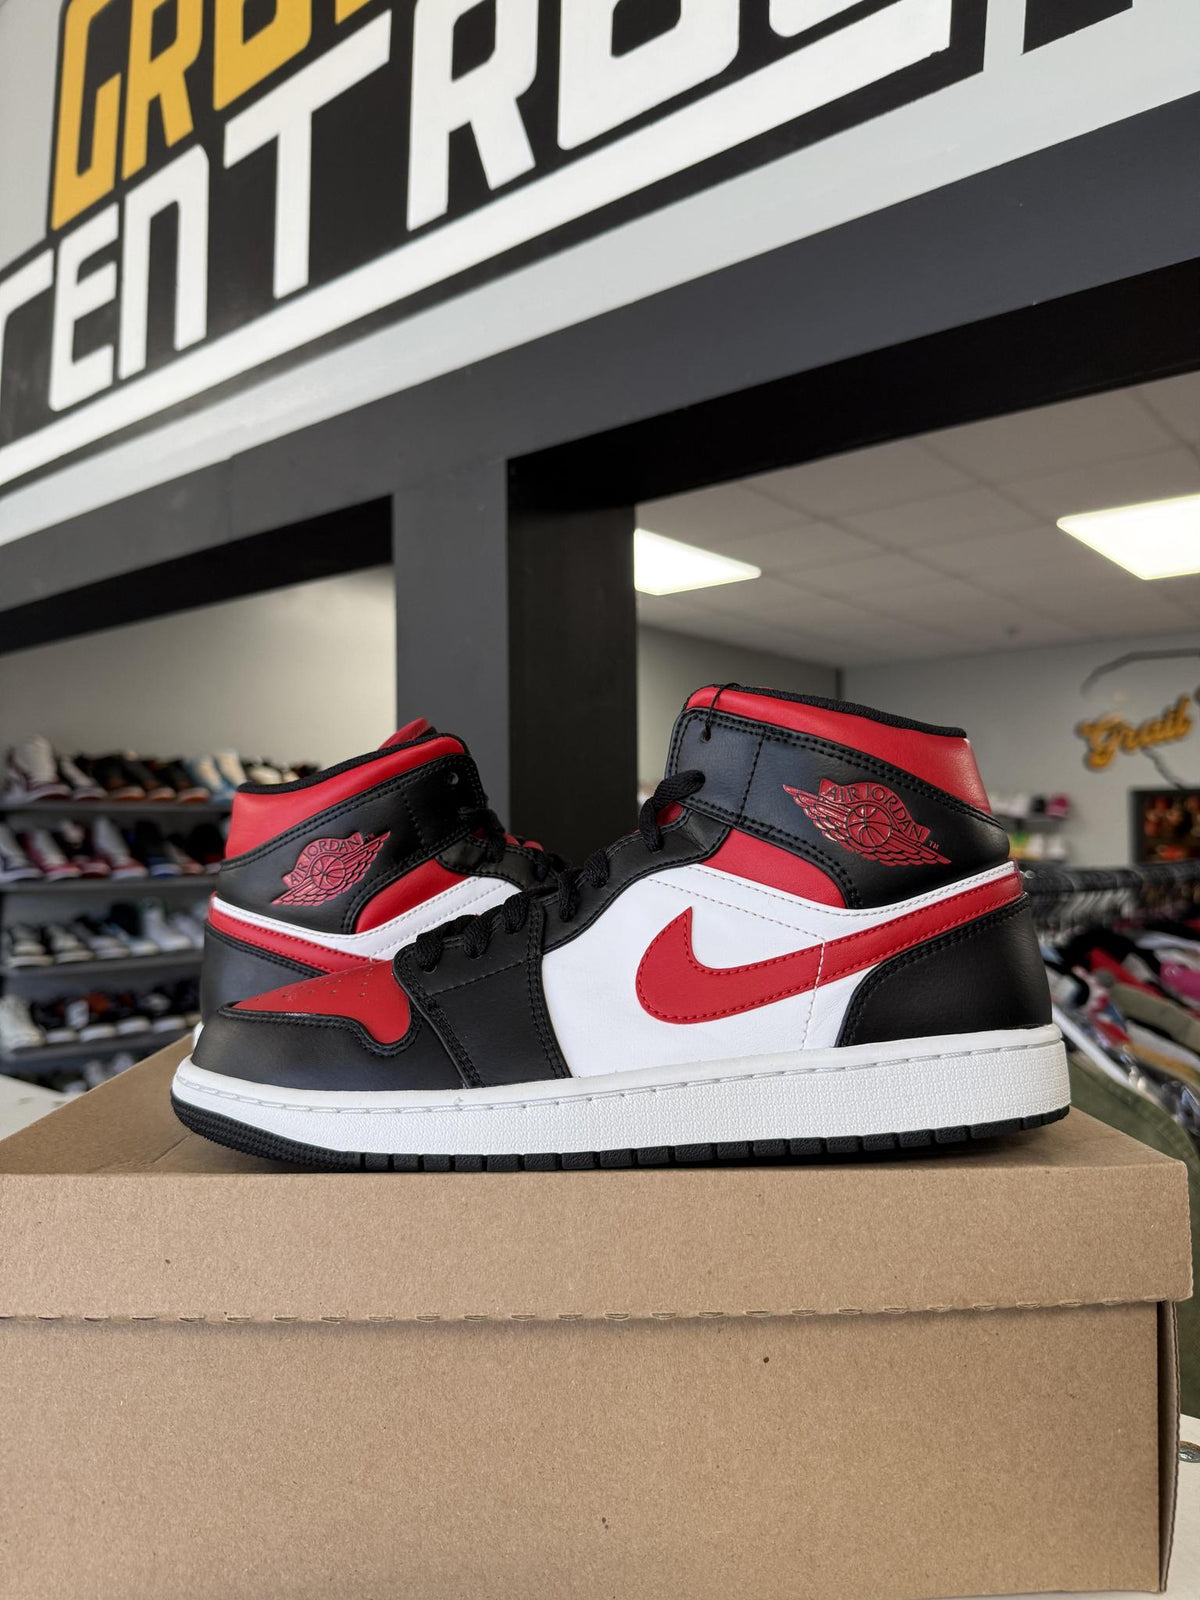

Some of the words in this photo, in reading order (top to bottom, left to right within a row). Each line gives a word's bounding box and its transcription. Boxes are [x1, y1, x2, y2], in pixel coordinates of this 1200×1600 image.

[826, 787, 859, 801] AIR
[865, 784, 924, 840] JORDAN
[290, 862, 308, 885] AIR
[303, 840, 361, 860] JORDAN
